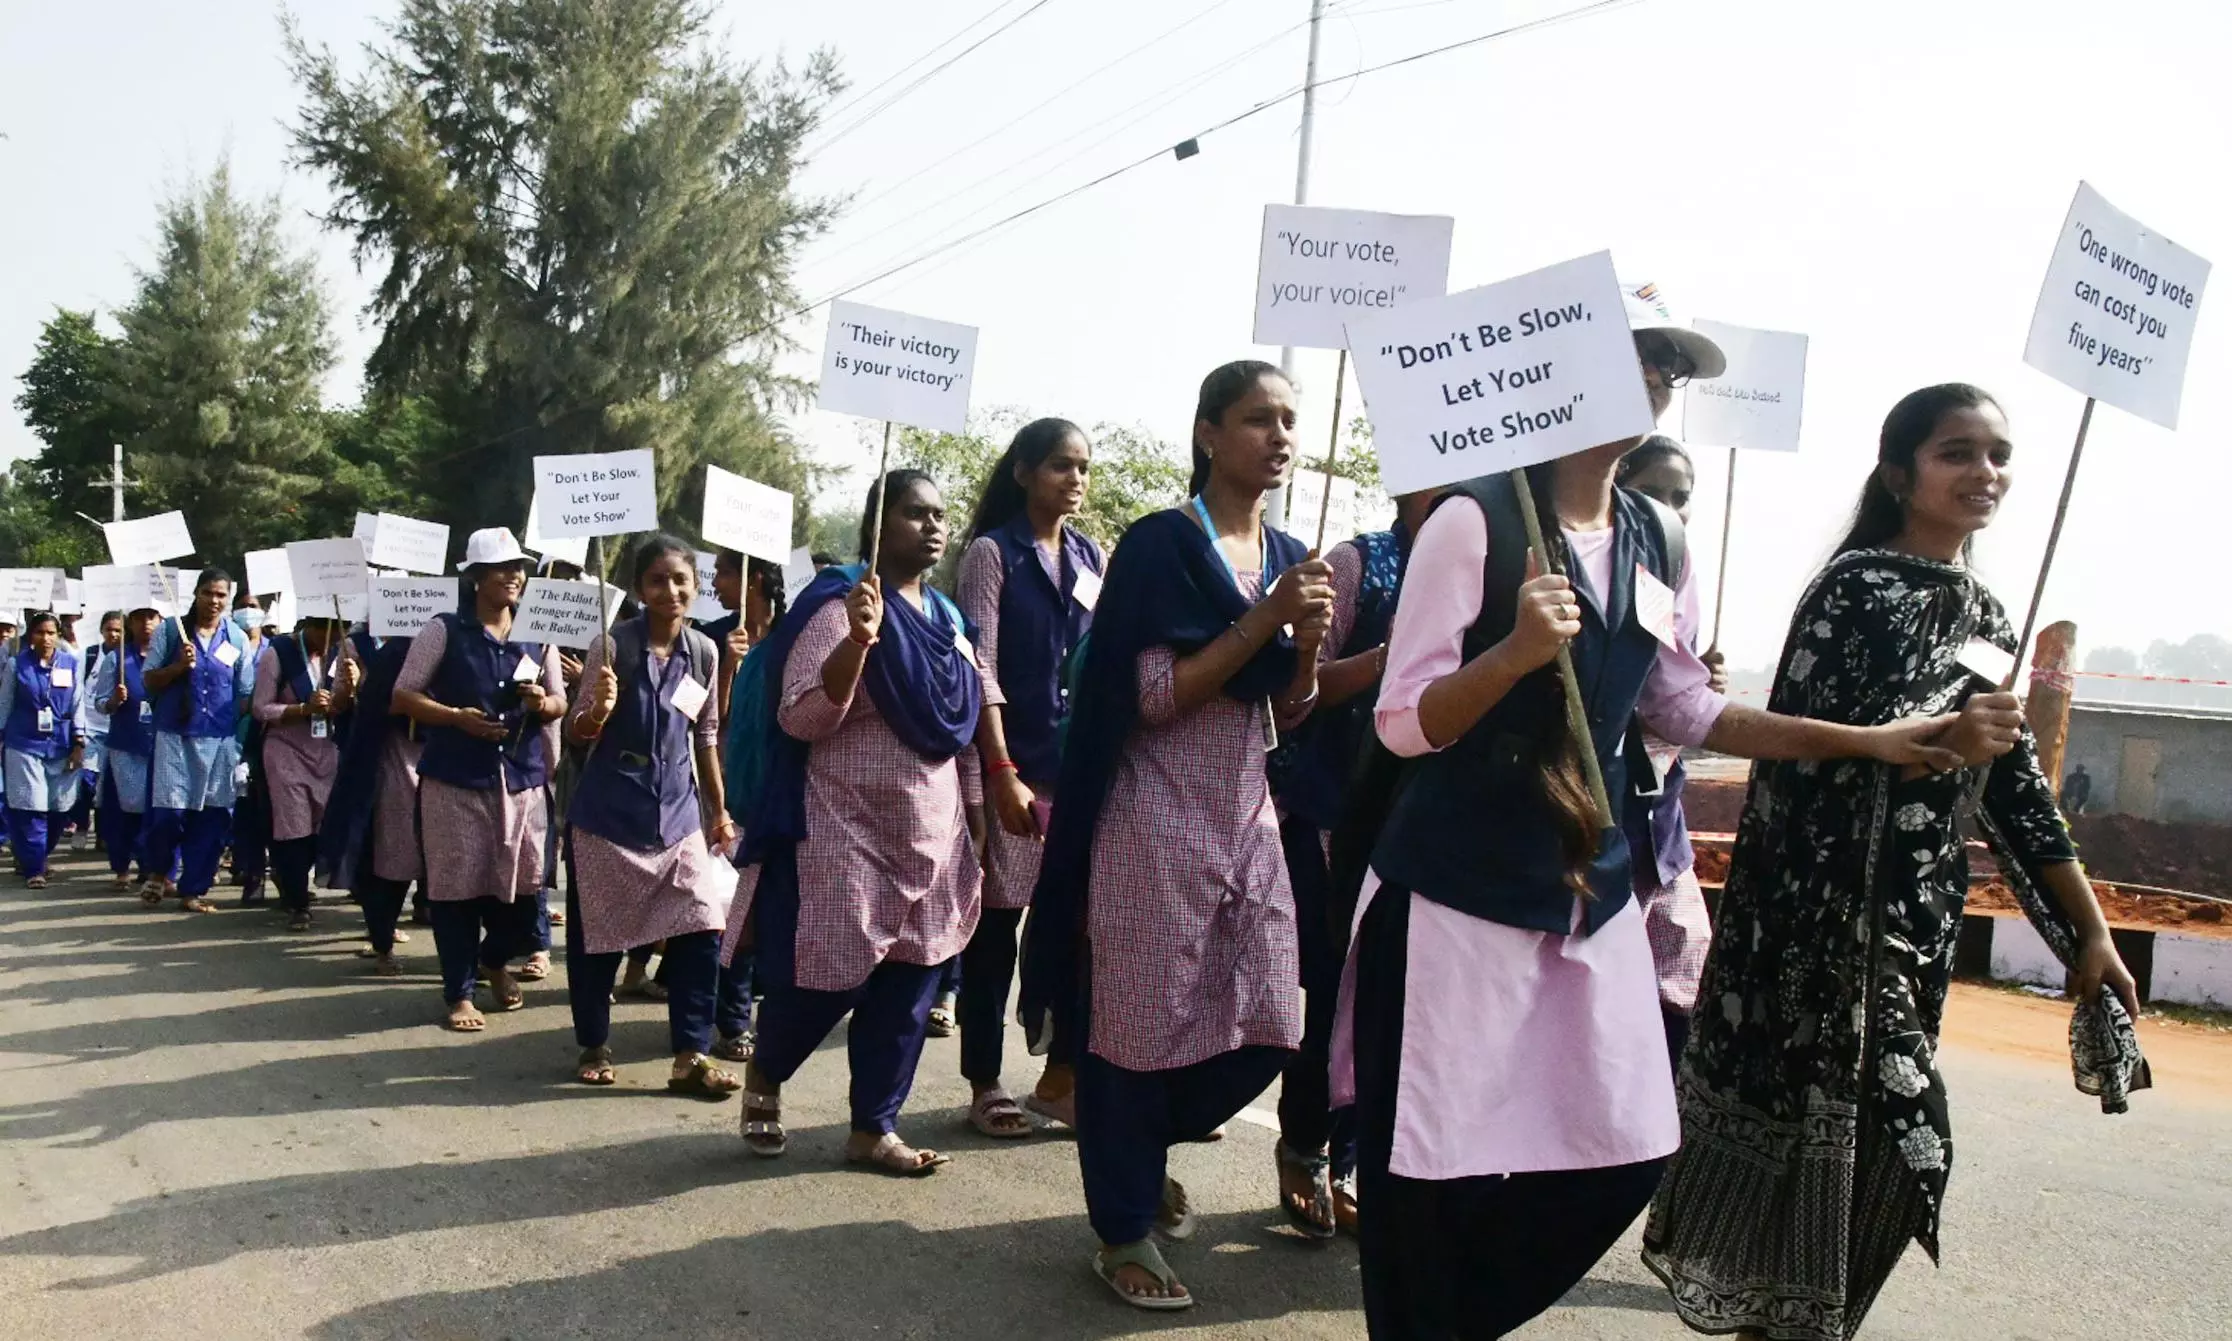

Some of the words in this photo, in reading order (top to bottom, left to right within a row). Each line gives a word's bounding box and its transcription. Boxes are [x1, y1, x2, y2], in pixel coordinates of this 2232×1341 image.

[1278, 231, 1339, 259] “Your
[1346, 240, 1400, 267] vote,
[2075, 222, 2110, 264] “One
[2110, 248, 2158, 295] wrong
[2162, 277, 2195, 309] vote
[1270, 282, 1324, 308] your
[2074, 280, 2100, 307] can
[2103, 295, 2136, 324] cost
[2136, 309, 2168, 339] you
[841, 321, 896, 348] “Their
[901, 336, 960, 364] victory
[1380, 331, 1473, 370] “Don’t
[1477, 323, 1513, 348] Be
[1518, 301, 1592, 337] Slow,
[2068, 321, 2097, 355] five
[2097, 342, 2153, 375] years”
[835, 351, 848, 370] is
[852, 359, 893, 376] your
[897, 364, 964, 392] victory”
[1441, 377, 1485, 406] Let
[1488, 360, 1554, 393] Your
[1429, 426, 1495, 455] Vote
[1501, 393, 1584, 439] Show”
[547, 471, 589, 484] “Don’t
[591, 470, 607, 482] Be
[609, 468, 641, 481] Slow,
[571, 493, 590, 504] Let
[592, 491, 621, 502] Your
[562, 514, 591, 525] Vote
[410, 588, 423, 599] Be
[424, 588, 449, 599] Slow,
[535, 588, 560, 601] “The
[562, 591, 594, 606] Ballot
[394, 603, 409, 614] Let
[410, 603, 433, 614] Your
[529, 605, 572, 619] stronger
[574, 610, 599, 623] than
[387, 618, 410, 628] Vote
[529, 620, 547, 632] the
[548, 621, 588, 637] Ballet”
